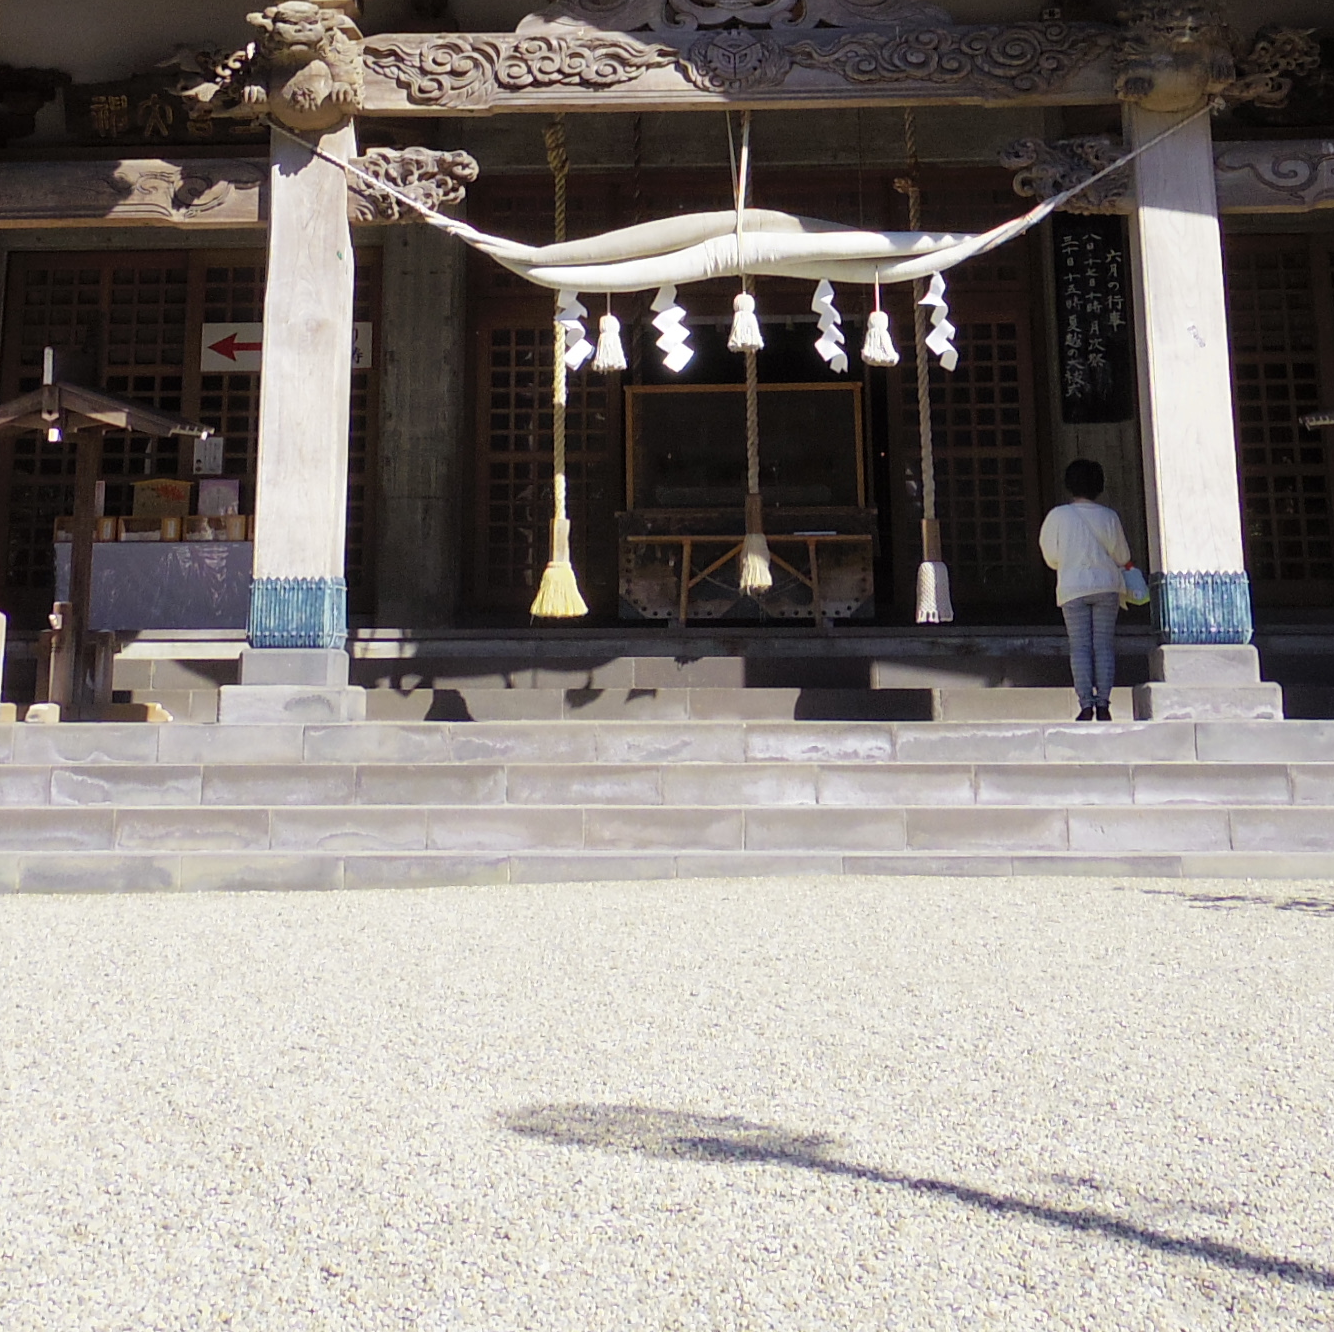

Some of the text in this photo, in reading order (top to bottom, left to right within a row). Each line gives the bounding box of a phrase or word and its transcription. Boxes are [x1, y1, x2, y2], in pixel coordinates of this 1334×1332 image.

[1105, 249, 1126, 332] 六月の行事
